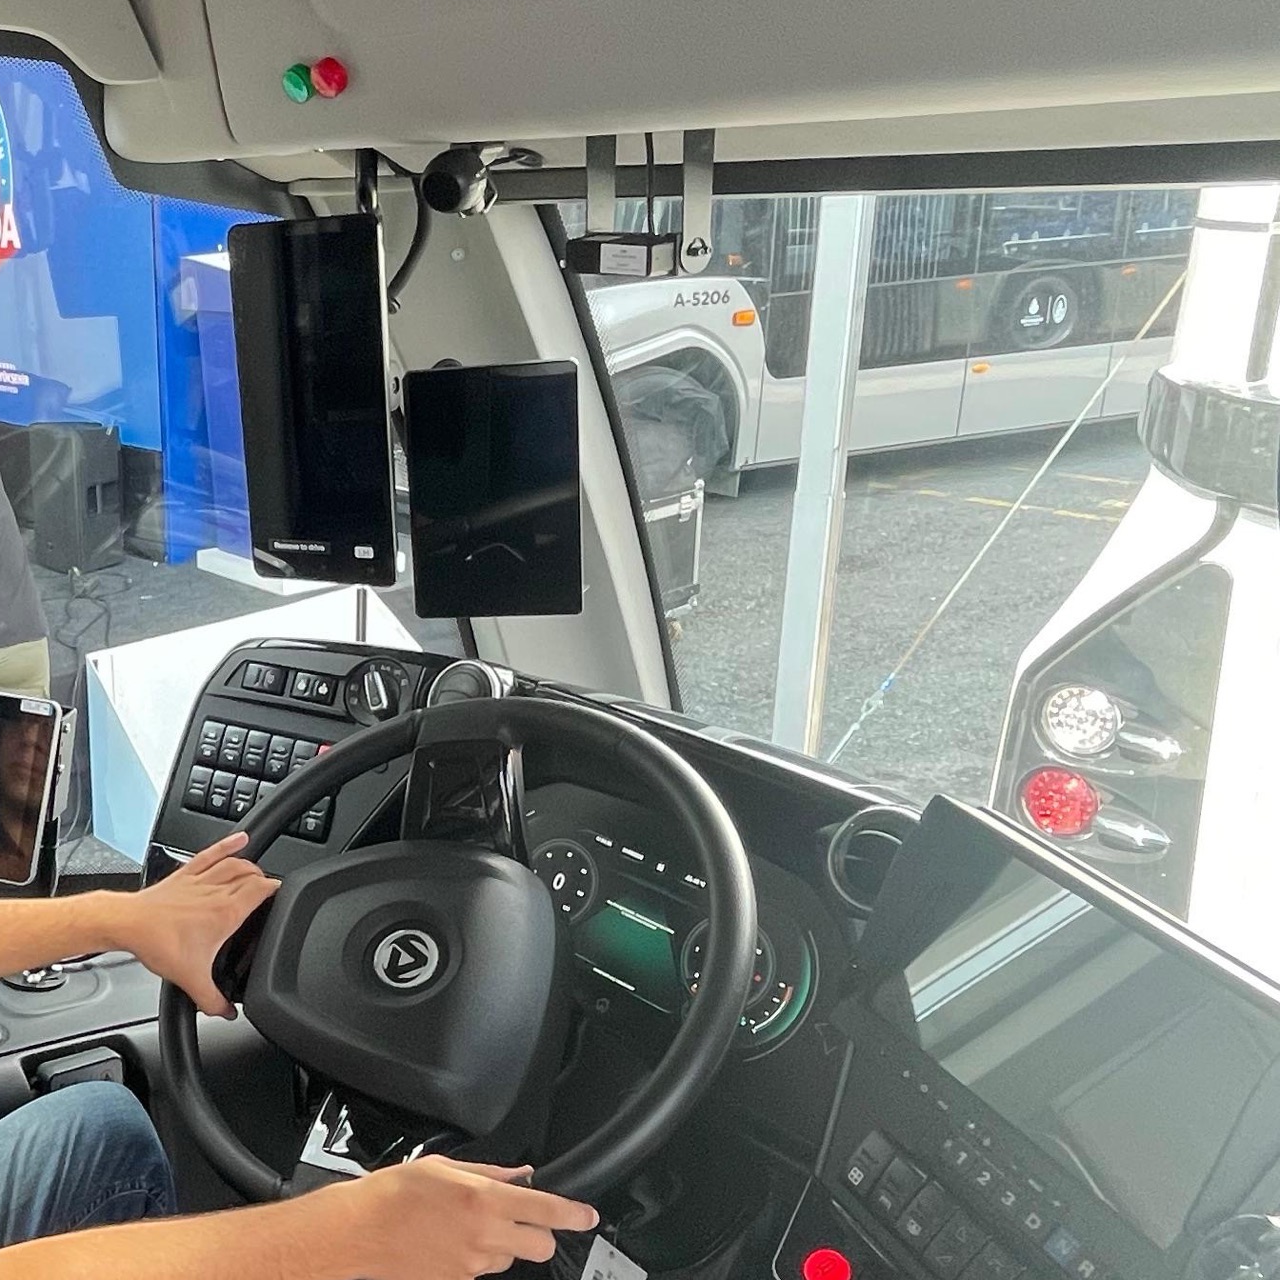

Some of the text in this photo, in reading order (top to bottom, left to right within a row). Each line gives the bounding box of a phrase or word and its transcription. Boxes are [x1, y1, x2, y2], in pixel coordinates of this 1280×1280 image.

[673, 290, 731, 308] A-5206
[552, 872, 566, 891] 0
[956, 1151, 967, 1165] 1
[977, 1171, 991, 1186] 2
[1001, 1191, 1016, 1206] 3
[1024, 1212, 1042, 1230] D
[1078, 1260, 1096, 1279] R
